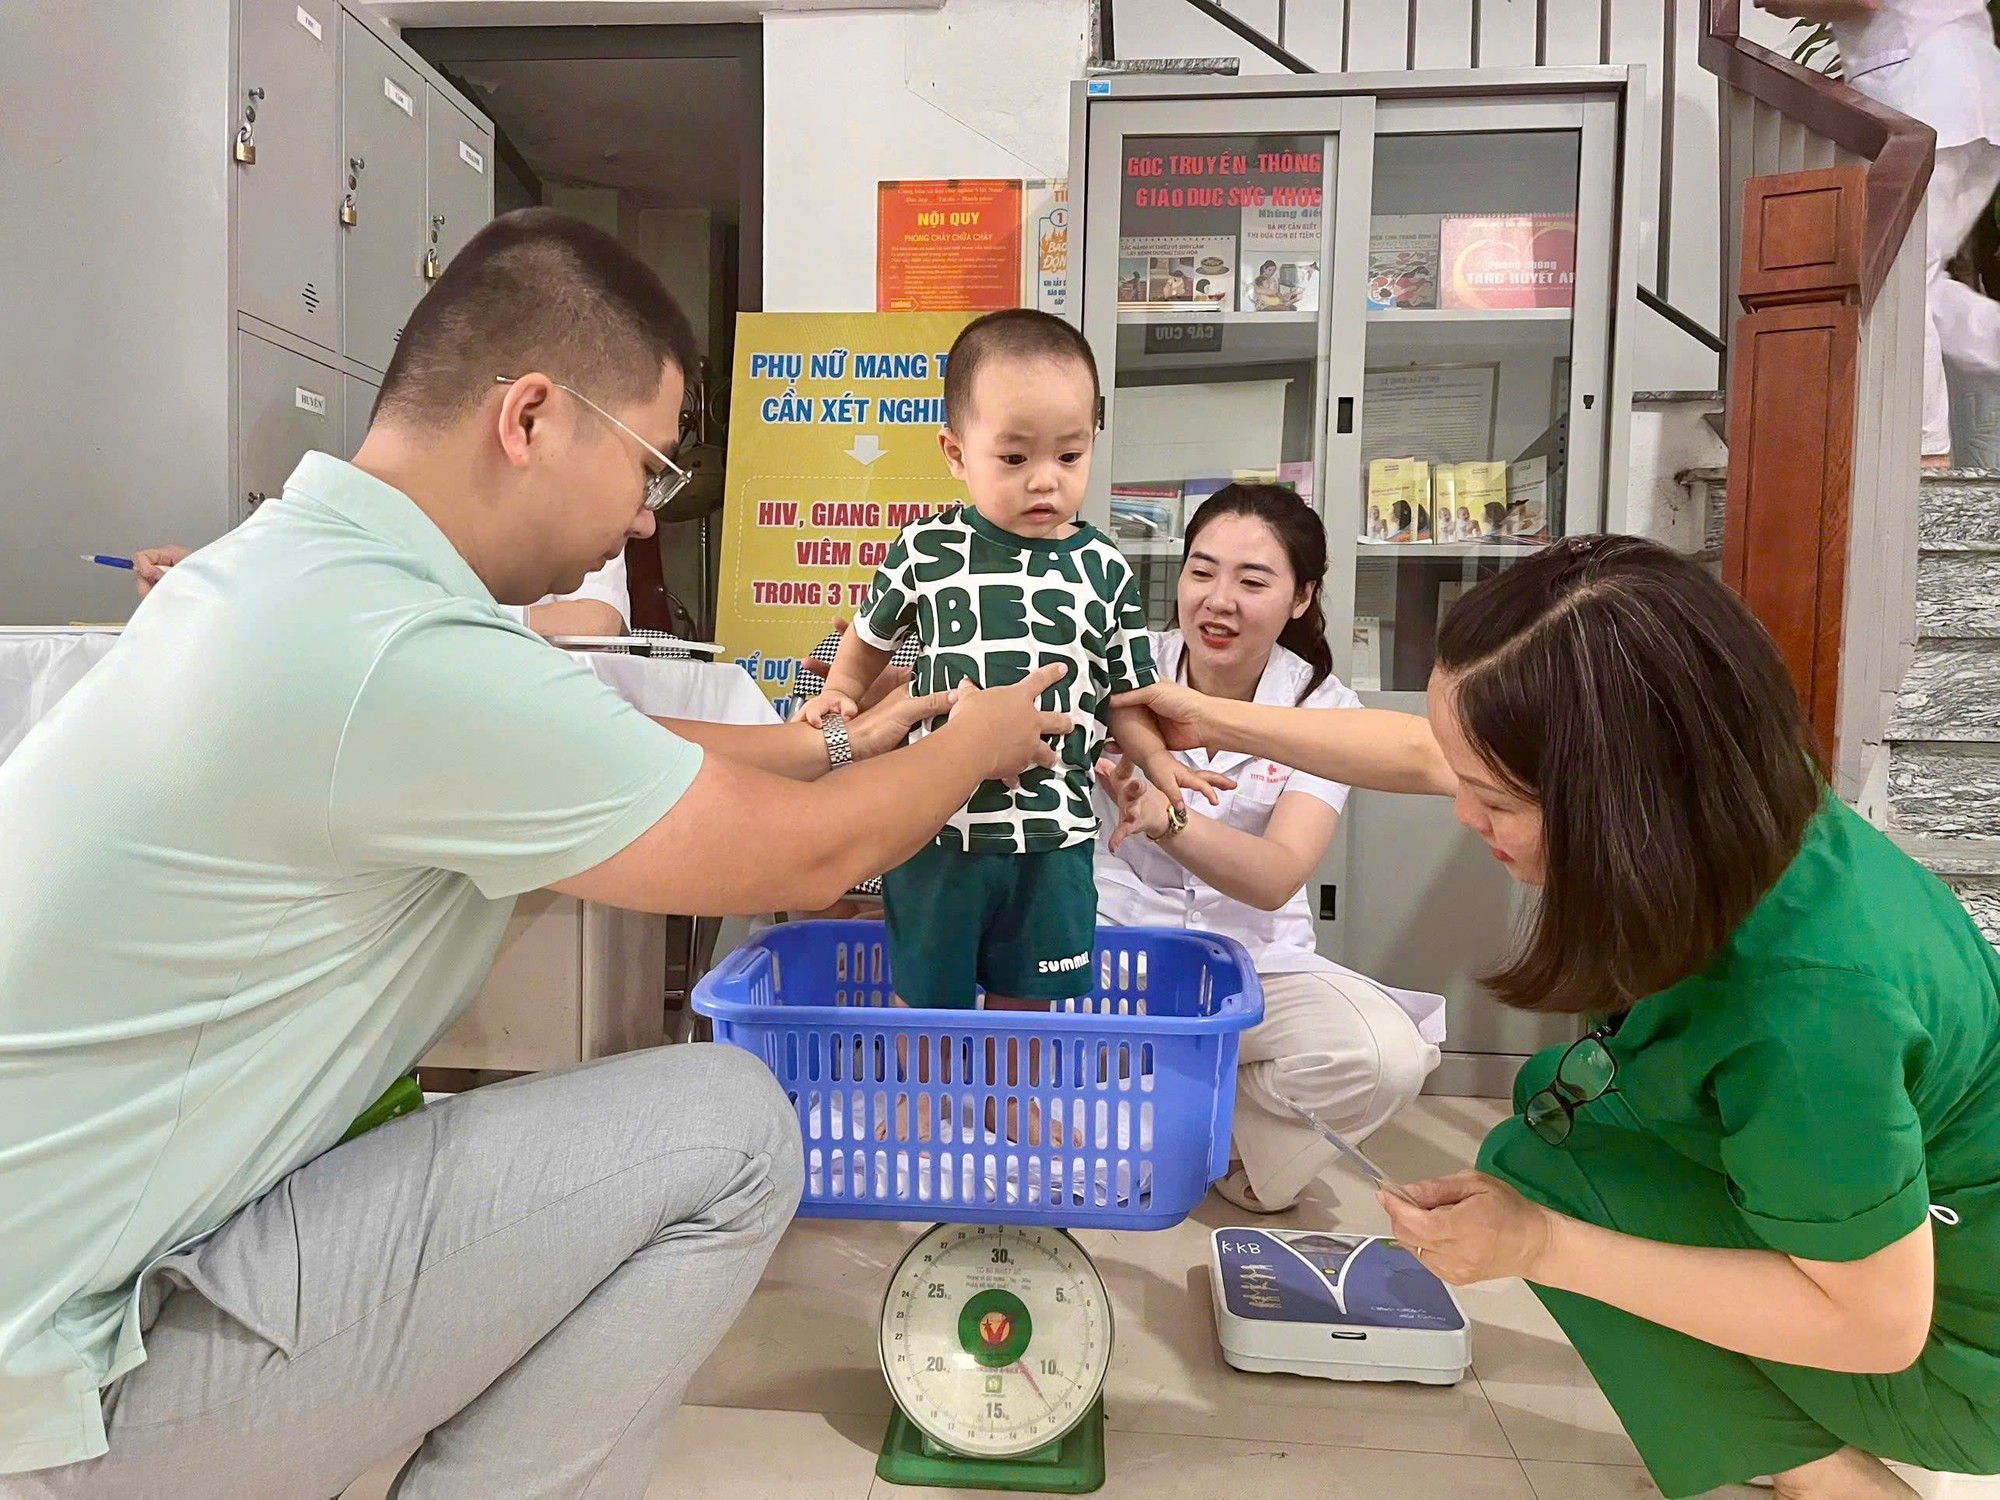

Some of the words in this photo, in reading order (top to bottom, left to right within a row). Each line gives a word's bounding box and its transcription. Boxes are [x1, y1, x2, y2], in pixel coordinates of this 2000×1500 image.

[1257, 149, 1320, 174] THÔNG
[917, 210, 945, 228] NỘI
[950, 211, 980, 227] QUY
[1056, 212, 1063, 224] 1
[751, 355, 801, 383] PHỤ
[811, 350, 848, 378] NỮ
[855, 355, 927, 378] MANG
[762, 389, 812, 422] CẦN
[821, 393, 869, 422] XÉT
[758, 502, 804, 528] HIV,
[812, 503, 880, 527] GIANG
[797, 538, 851, 565] VIÊM
[859, 543, 893, 566] GA
[753, 582, 822, 604] TRONG
[828, 583, 842, 605] 3
[764, 658, 792, 685] DỰ
